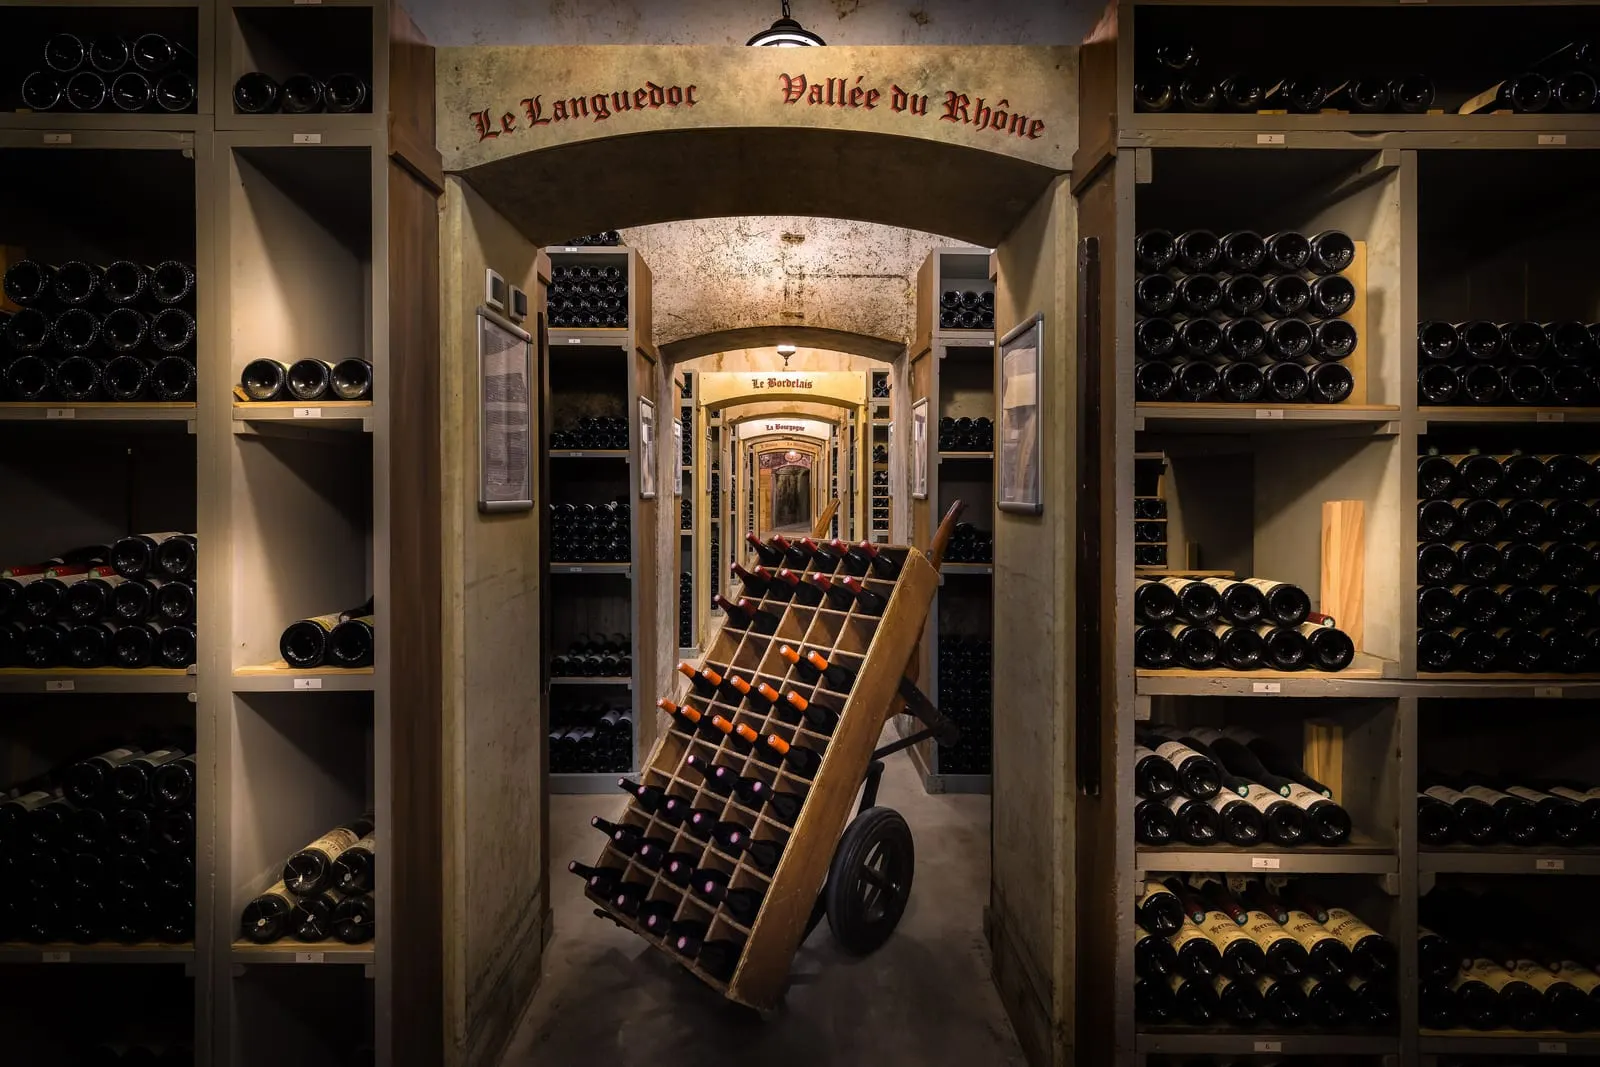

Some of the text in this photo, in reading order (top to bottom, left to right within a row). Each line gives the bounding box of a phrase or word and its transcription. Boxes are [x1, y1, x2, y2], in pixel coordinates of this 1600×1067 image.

[469, 81, 698, 143] Le Languedoc
[779, 72, 1046, 140] Vallée du Rhône
[751, 377, 813, 389] Le Bordelais
[775, 423, 805, 431] Bourgogne
